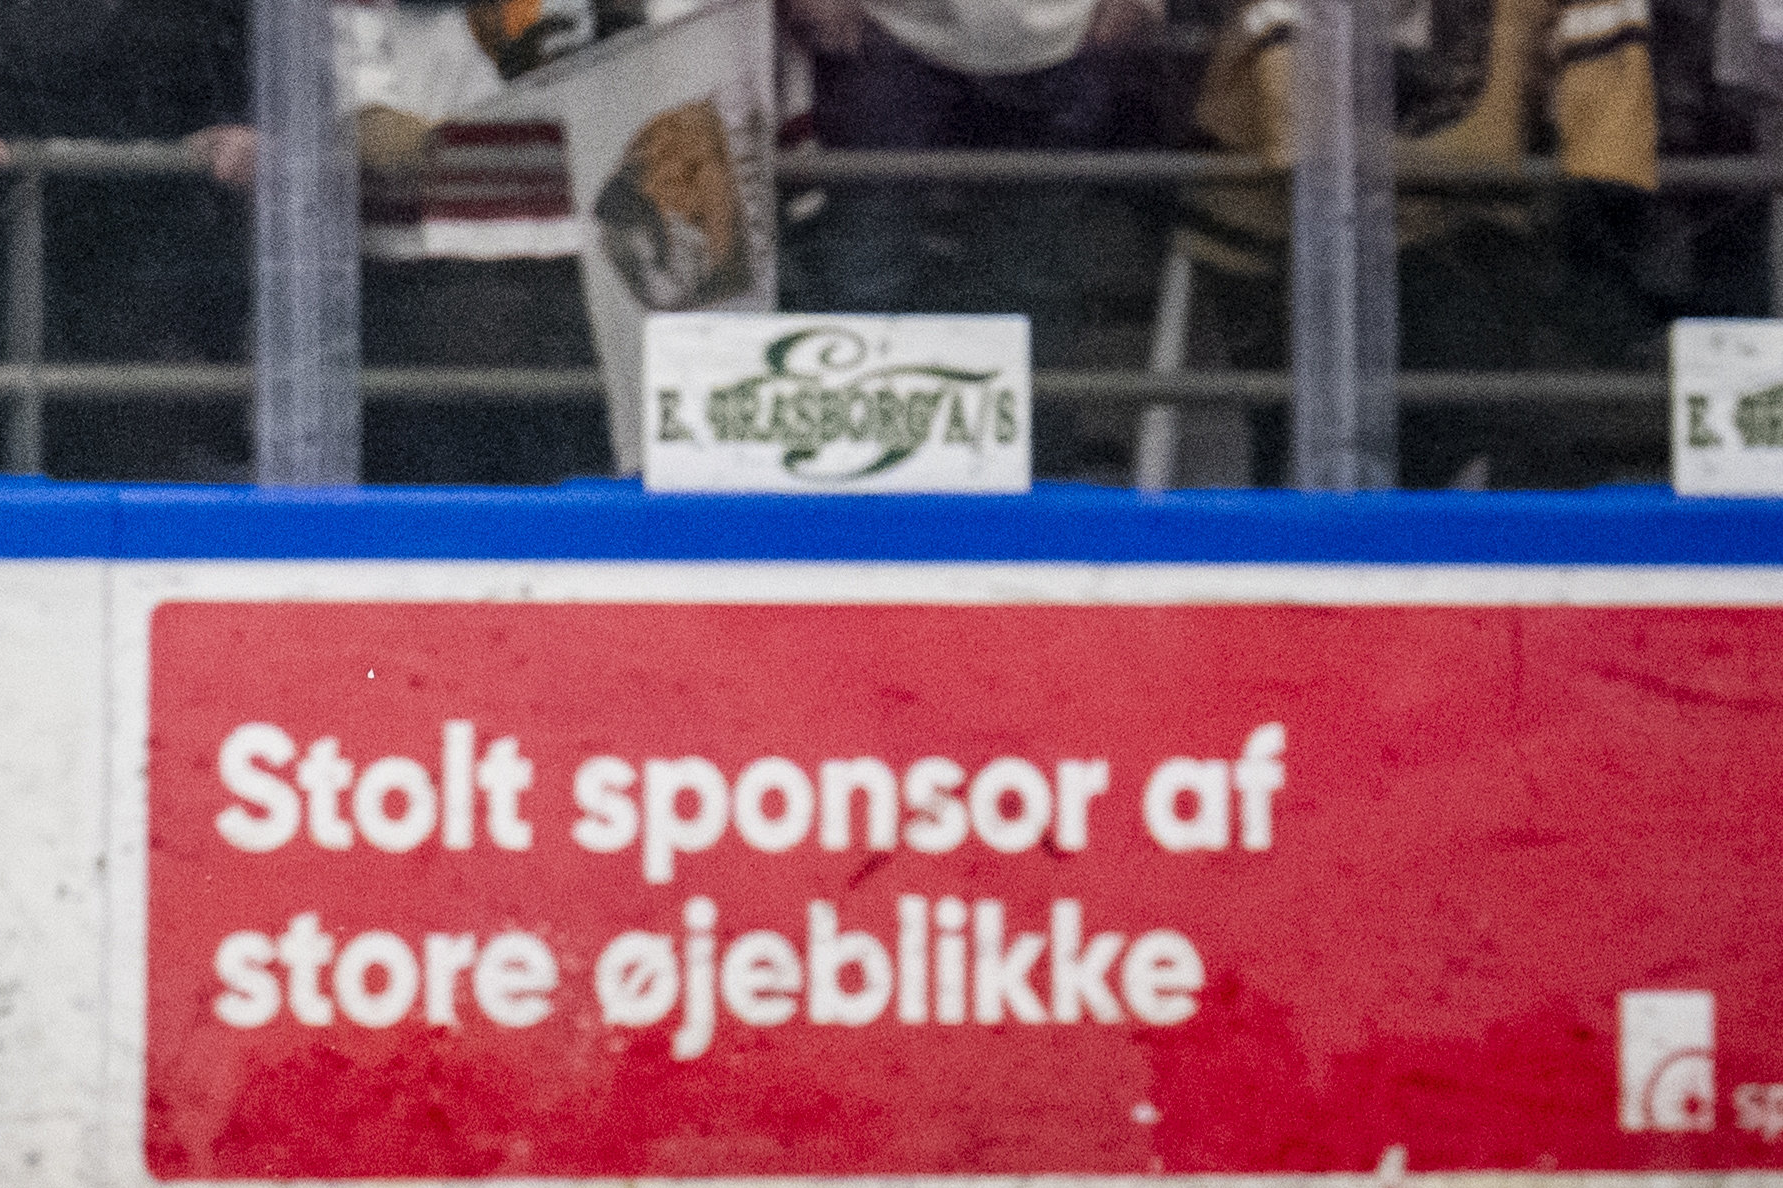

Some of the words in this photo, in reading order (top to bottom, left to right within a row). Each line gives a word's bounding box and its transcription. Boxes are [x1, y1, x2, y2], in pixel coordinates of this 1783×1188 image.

[215, 717, 535, 854] Stolt
[570, 752, 1109, 885] sponsor
[1141, 720, 1288, 853] af
[213, 911, 560, 1028] store
[593, 893, 1208, 1062] øjeblikke
